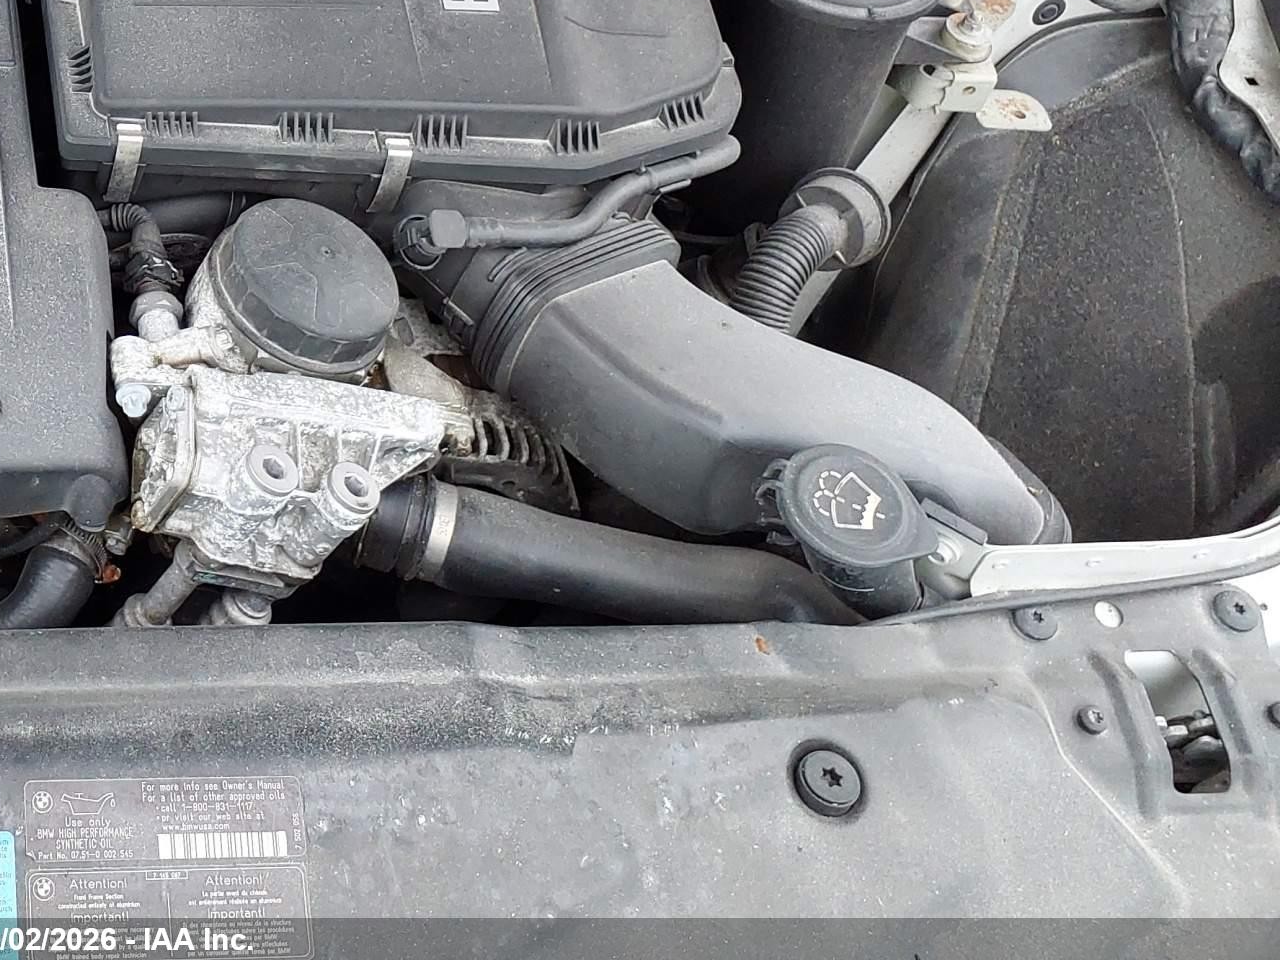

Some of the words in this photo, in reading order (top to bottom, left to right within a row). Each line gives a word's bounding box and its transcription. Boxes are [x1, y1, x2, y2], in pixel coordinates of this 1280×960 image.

[141, 782, 155, 792] For
[222, 780, 252, 790] Owner's
[257, 780, 284, 790] Manual
[142, 792, 155, 802] For
[190, 792, 198, 801] of
[203, 792, 224, 801] other
[229, 791, 265, 803] approved
[269, 790, 285, 800] oils
[161, 803, 176, 812] call
[216, 812, 231, 820] web
[256, 811, 264, 820] at
[65, 816, 82, 827] Use
[89, 816, 111, 828] only
[162, 823, 230, 831] www.bmwusa.com
[37, 828, 54, 839] BMW
[59, 828, 77, 838] HIGH
[80, 826, 134, 839] PERFORMANCE
[55, 839, 97, 850] SYNTHETIC
[100, 839, 114, 849] OIL
[38, 851, 53, 860] Part
